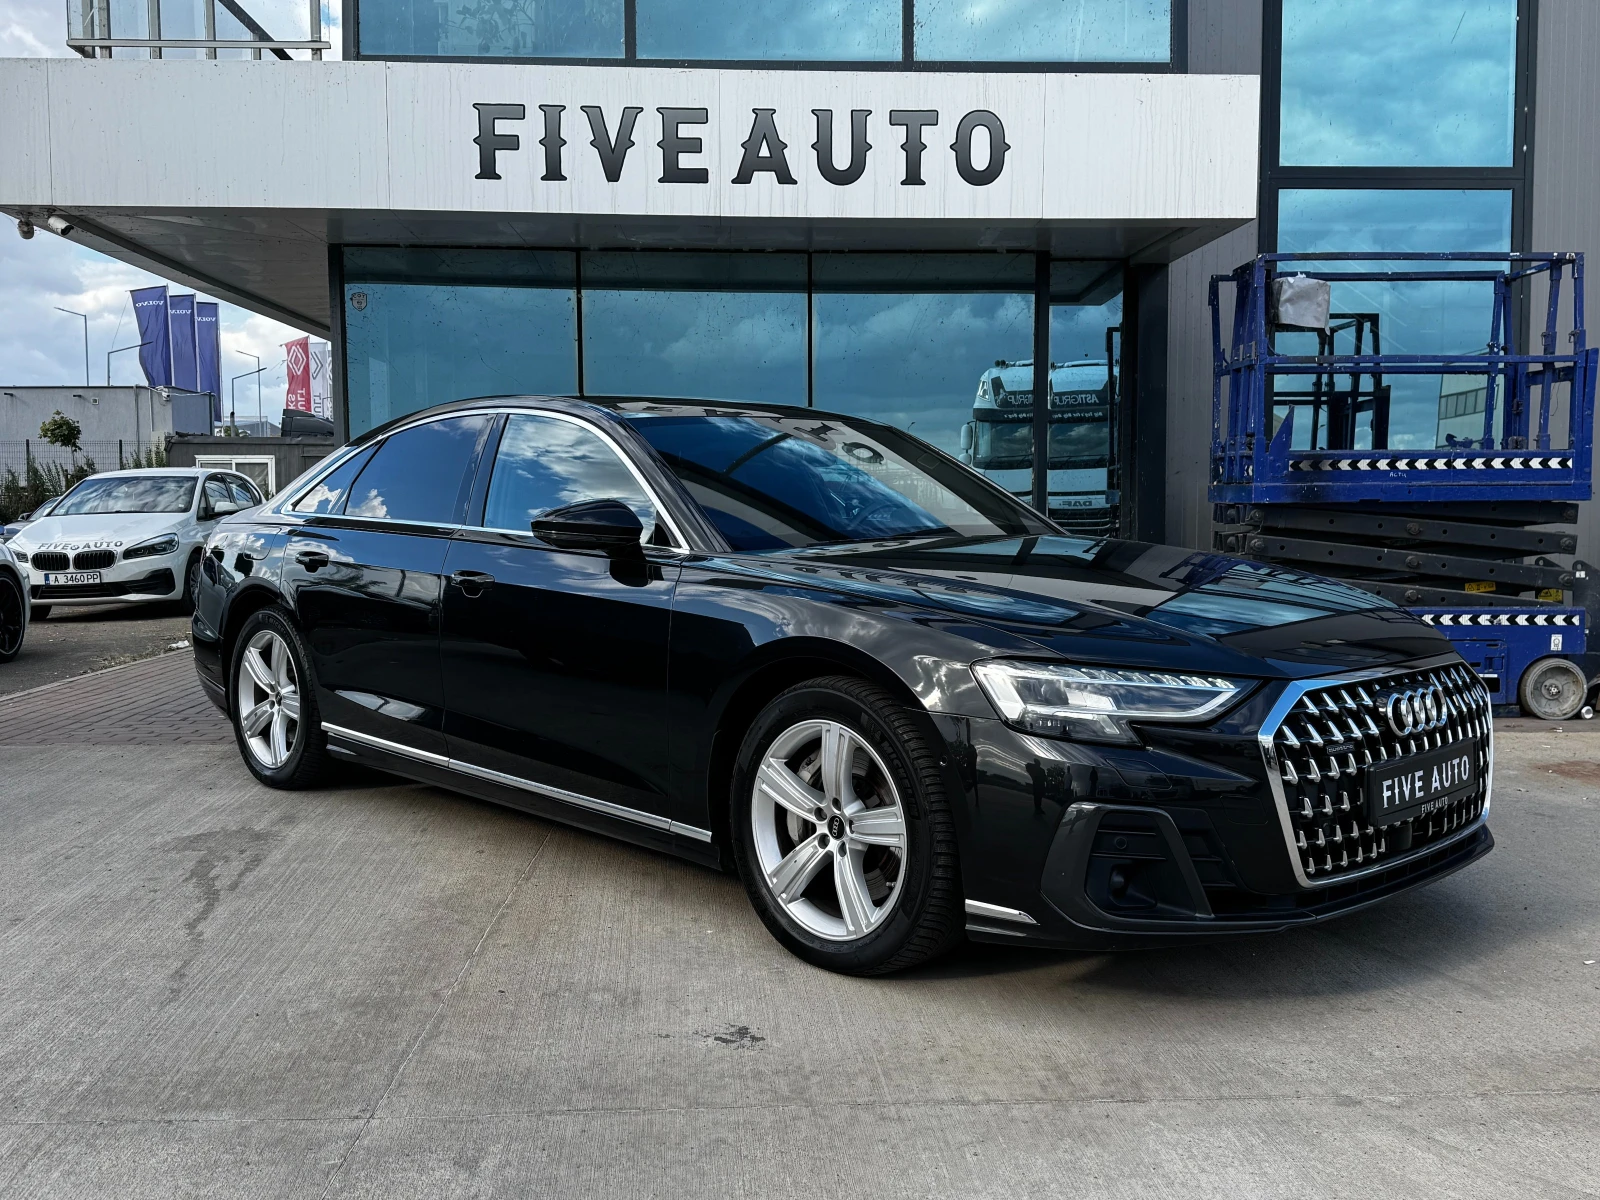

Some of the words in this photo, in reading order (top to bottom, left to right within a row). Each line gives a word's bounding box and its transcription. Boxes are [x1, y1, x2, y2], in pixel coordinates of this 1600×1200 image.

[82, 541, 123, 549] AUTO
[1382, 770, 1424, 808] FIVE
[1430, 755, 1470, 793] AUTO
[1421, 800, 1435, 814] FIVE
[1435, 797, 1448, 808] AUTO
